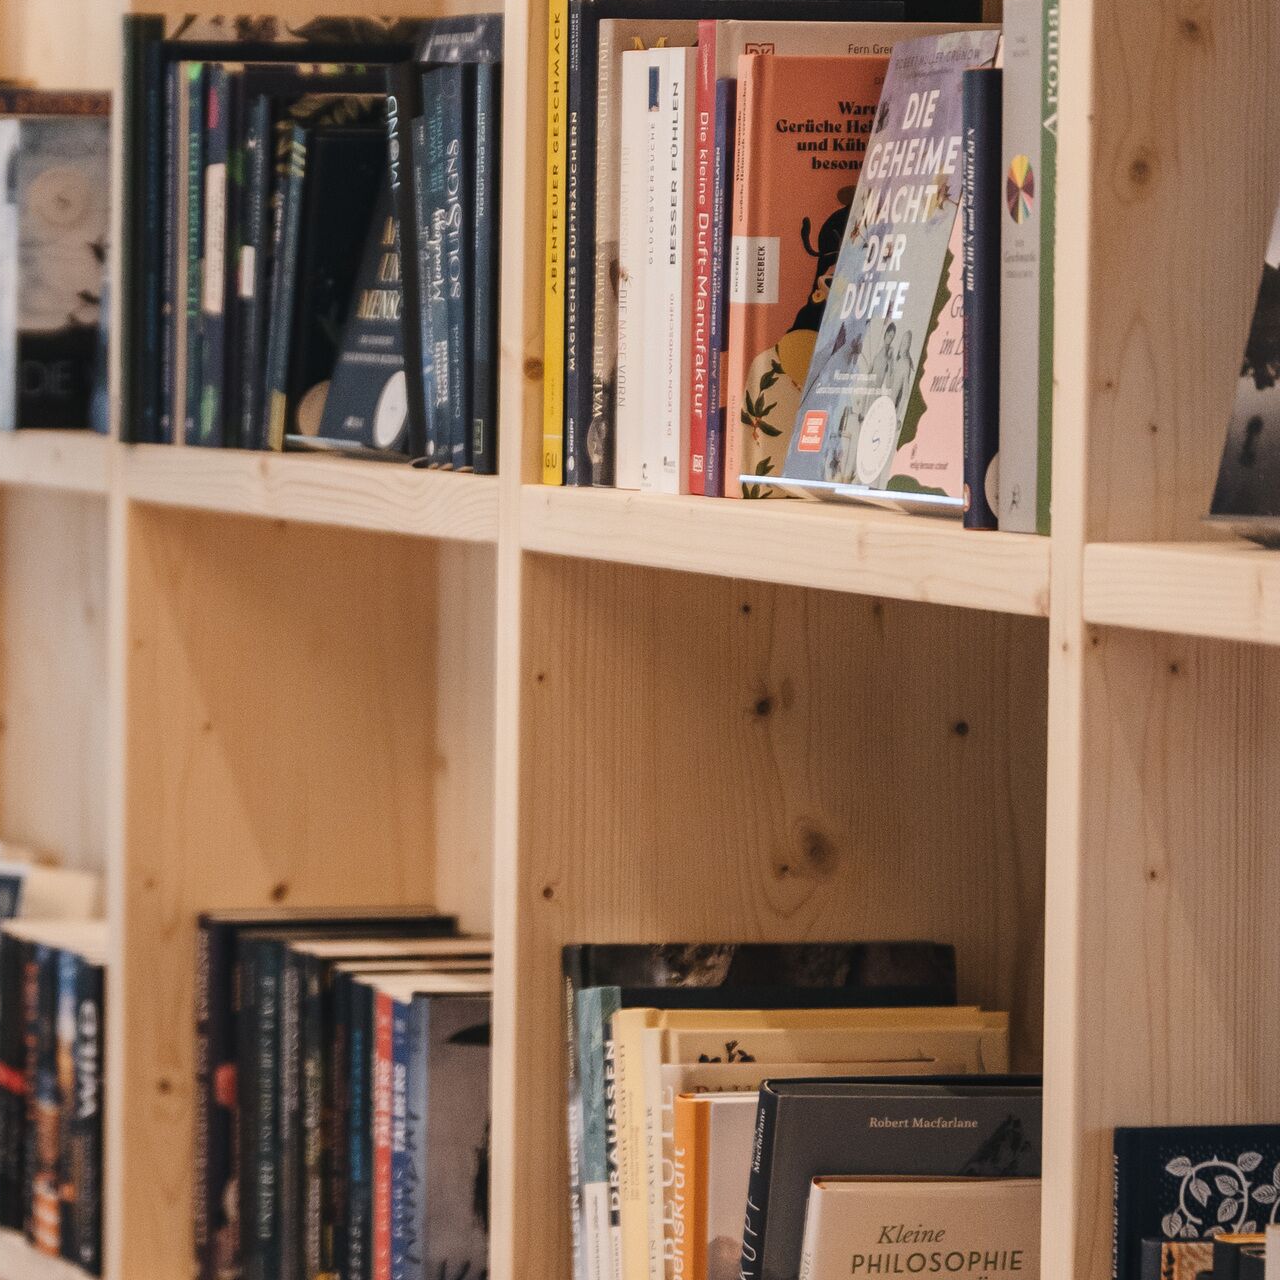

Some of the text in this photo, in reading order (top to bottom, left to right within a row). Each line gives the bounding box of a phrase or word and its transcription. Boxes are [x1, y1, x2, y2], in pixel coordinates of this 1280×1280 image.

[847, 42, 870, 55] Fern
[776, 118, 842, 134] Gerüche
[902, 88, 941, 130] DIE
[386, 94, 401, 191] MOND
[477, 111, 487, 217] Natur und Zahl
[550, 11, 562, 295] ABENTEUER GESCHMACK
[797, 138, 829, 152] und
[866, 133, 963, 181] GEHEIME
[647, 120, 657, 265] GLÜCKSVERSUCHE
[669, 81, 680, 265] BESSER FÜHLEN
[713, 146, 721, 222] EINSCHLAFEN
[444, 138, 462, 299] SOULSIGNS
[859, 183, 940, 225] MACHT
[430, 206, 447, 301] Moonology
[569, 110, 579, 371] MAGISCHES DUFTRÄUCHERN
[694, 111, 710, 421] Die kleine Duft-Manufaktur
[861, 232, 907, 273] DER
[757, 245, 766, 294] KNESEBECK
[839, 276, 910, 321] DÜFTE
[592, 342, 604, 418] WALSER
[544, 451, 558, 470] GU
[568, 417, 576, 453] KNEIPP
[707, 429, 717, 481] allegria
[606, 1040, 620, 1211] DRAUSSEN
[752, 1107, 767, 1174] Macfarlane
[868, 1115, 980, 1129] Robert Macfarlane
[644, 1105, 656, 1206] GÄRTNER
[877, 1223, 947, 1245] Kleine
[850, 1249, 1024, 1274] PHILOSOPHIE
